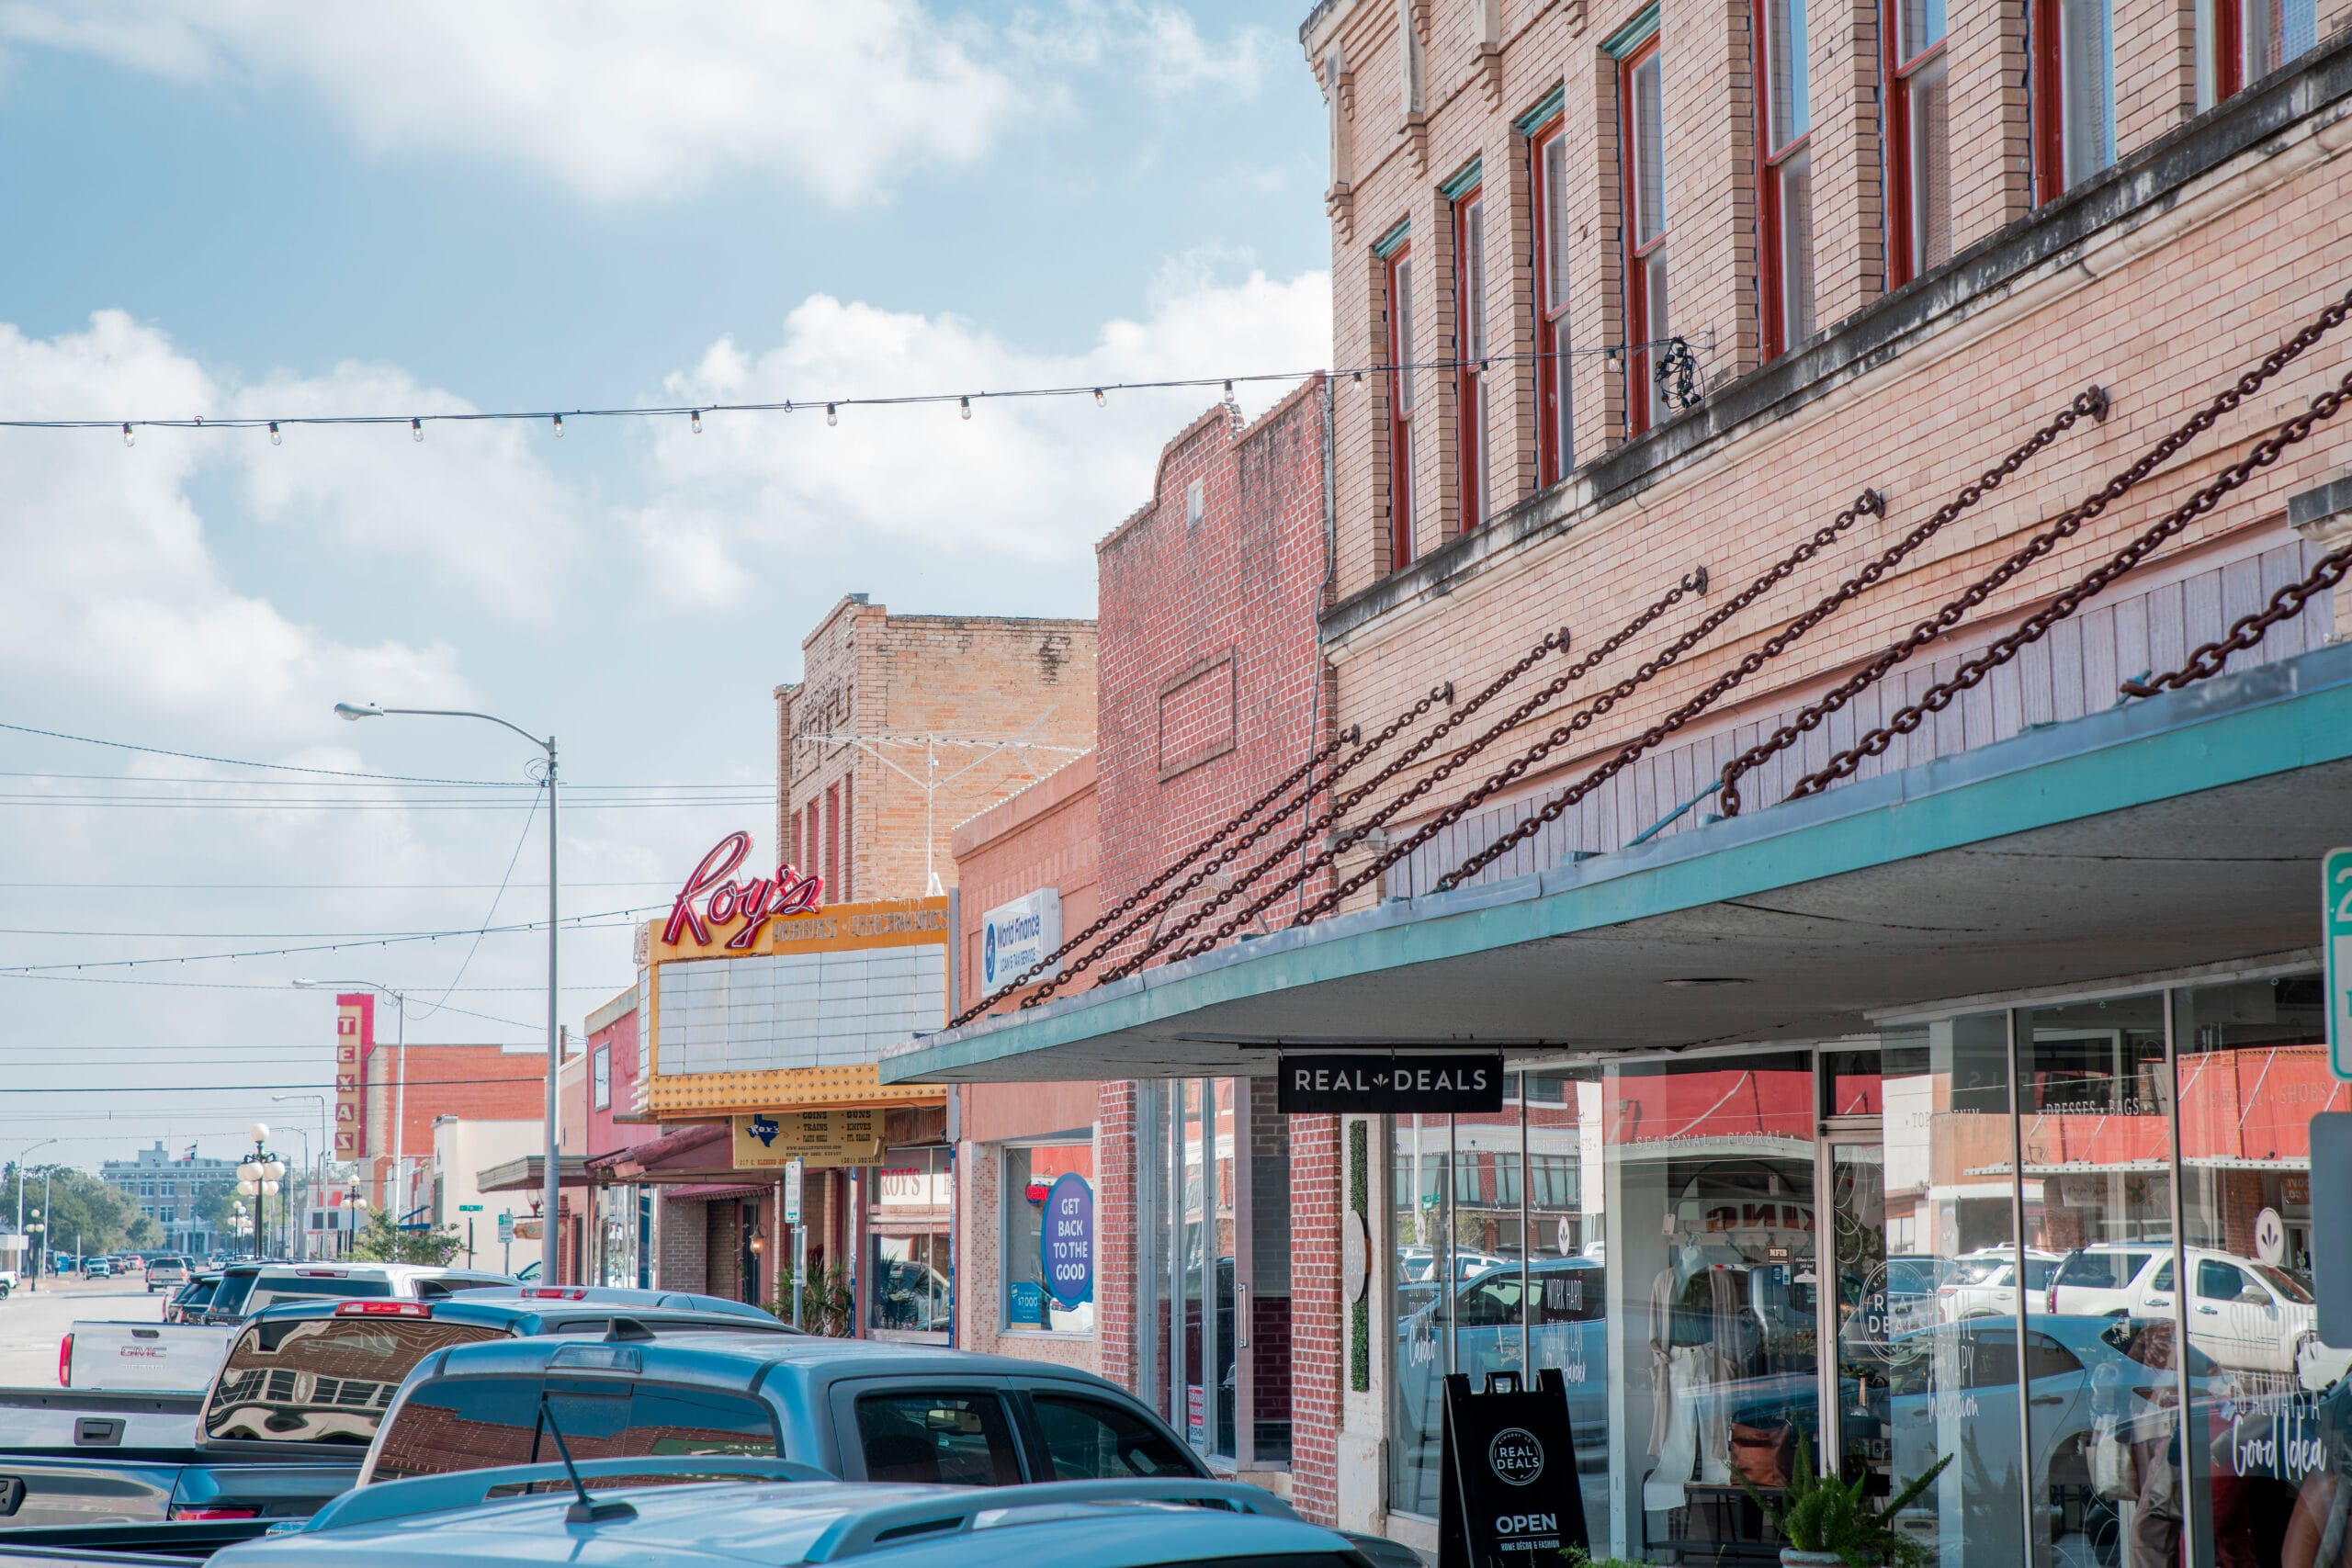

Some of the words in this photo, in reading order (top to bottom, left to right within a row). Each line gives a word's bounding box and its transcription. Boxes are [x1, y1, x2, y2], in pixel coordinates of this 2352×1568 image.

[662, 830, 824, 950] Roy's
[775, 918, 838, 942] HOBBIES
[852, 909, 949, 936] ELECTRONICS
[997, 919, 1014, 949] World
[1015, 914, 1040, 943] Finance
[1021, 947, 1036, 965] SERVICE
[337, 1017, 356, 1149] TEXAS
[1295, 1069, 1370, 1091] REAL
[1394, 1069, 1487, 1091] DEALS
[2280, 1081, 2328, 1105] SHOES
[846, 1111, 871, 1119] GUNS
[2046, 1100, 2097, 1118] DRESSES
[2109, 1097, 2140, 1117] BAGS
[803, 1123, 828, 1132] TRAINS
[846, 1122, 872, 1131] KNIVES
[1634, 1134, 1712, 1149] SEASONAL
[1726, 1130, 1784, 1146] FLORAL
[879, 1167, 921, 1197] ROY'S
[1061, 1198, 1080, 1216] GET
[1057, 1220, 1084, 1237] BACK
[1053, 1242, 1068, 1258] TO
[1069, 1241, 1088, 1258] THE
[1056, 1263, 1086, 1280] GOOD
[1546, 1279, 1566, 1310] WORK
[1566, 1280, 1582, 1311] HARD
[1874, 1293, 1922, 1314] RAL
[1570, 1320, 1583, 1352] CAN
[120, 1346, 167, 1359] GMC
[2252, 1371, 2306, 1420] ALWAYS
[1499, 1446, 1533, 1459] REAL
[2232, 1414, 2279, 1481] Good
[2283, 1408, 2327, 1481] Idea
[1497, 1457, 1540, 1470] DEALS
[1496, 1513, 1558, 1534] OPEN
[1500, 1542, 1516, 1551] HOME
[1538, 1539, 1560, 1550] FASHION
